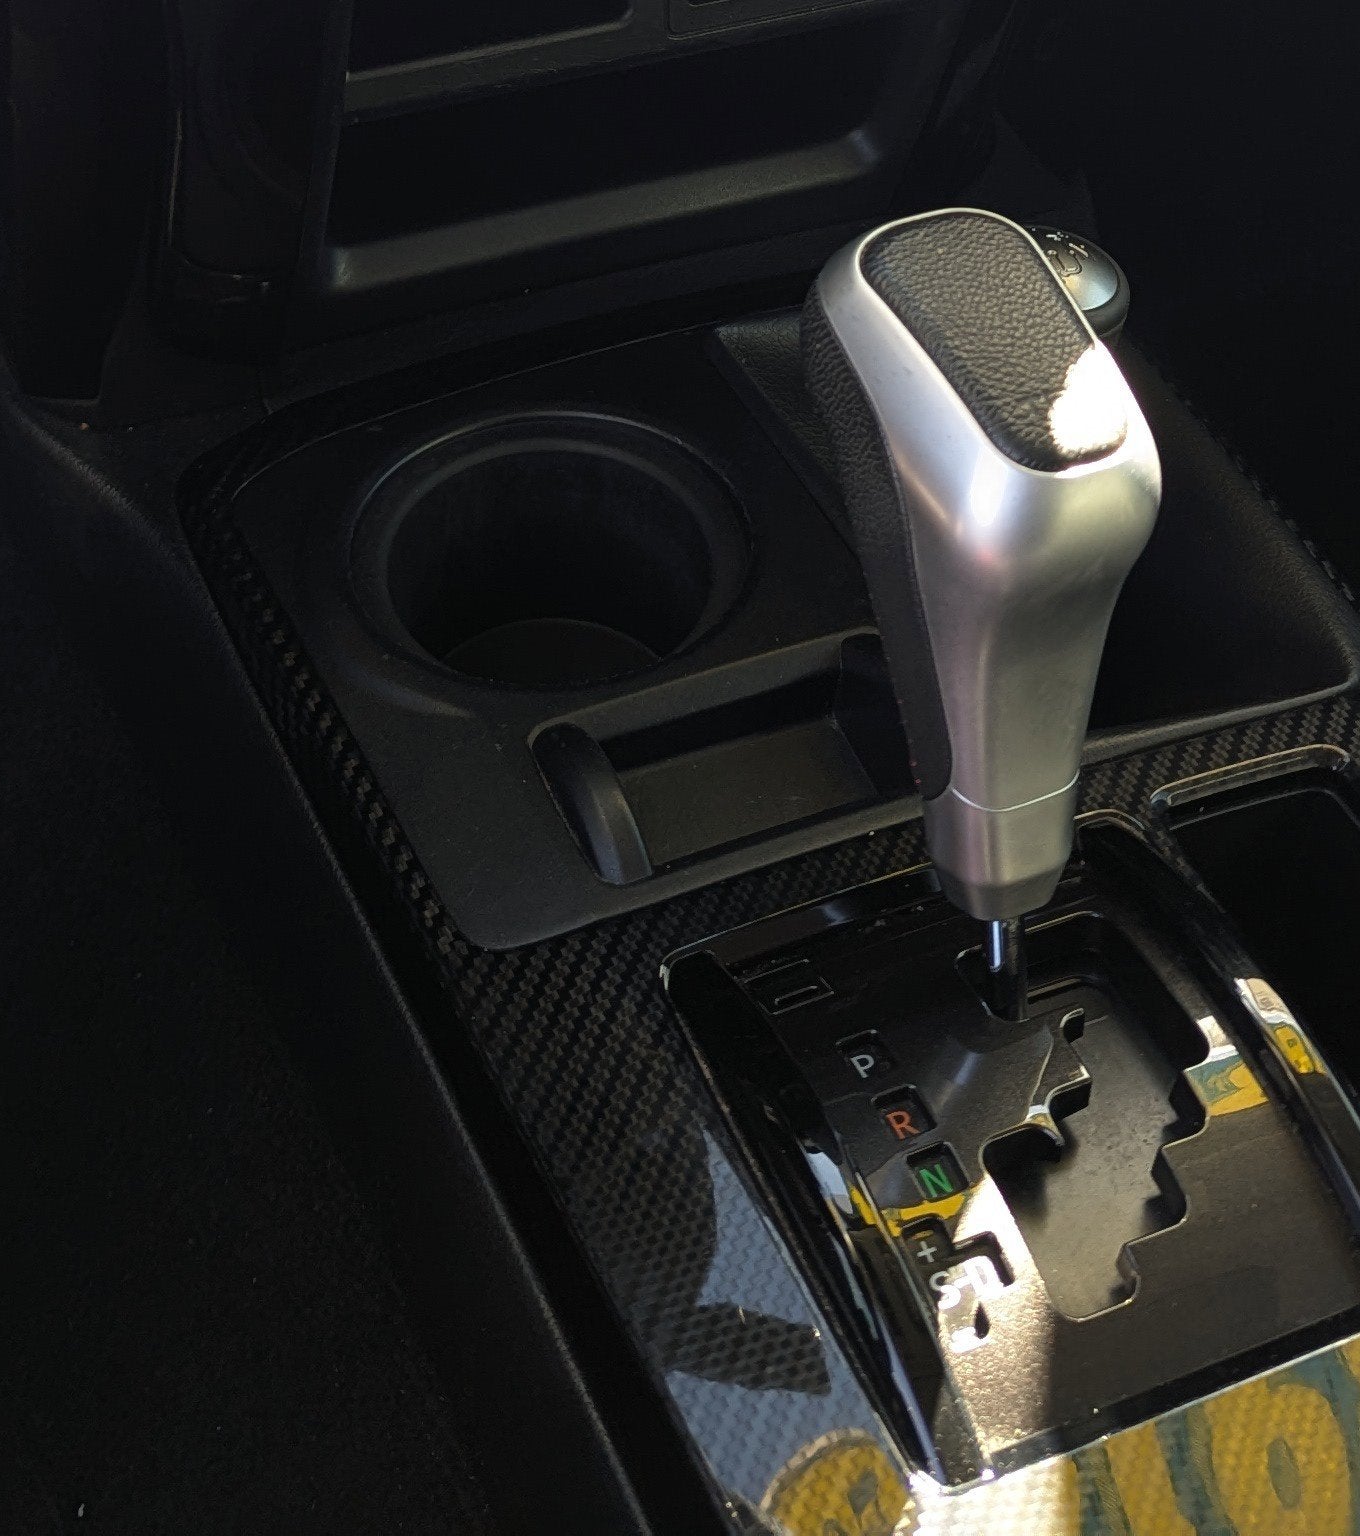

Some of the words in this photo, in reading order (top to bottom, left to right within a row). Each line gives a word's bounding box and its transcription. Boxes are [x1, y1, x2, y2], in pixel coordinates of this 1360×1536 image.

[850, 1054, 876, 1078] P
[885, 1110, 921, 1140] R
[919, 1165, 954, 1198] N
